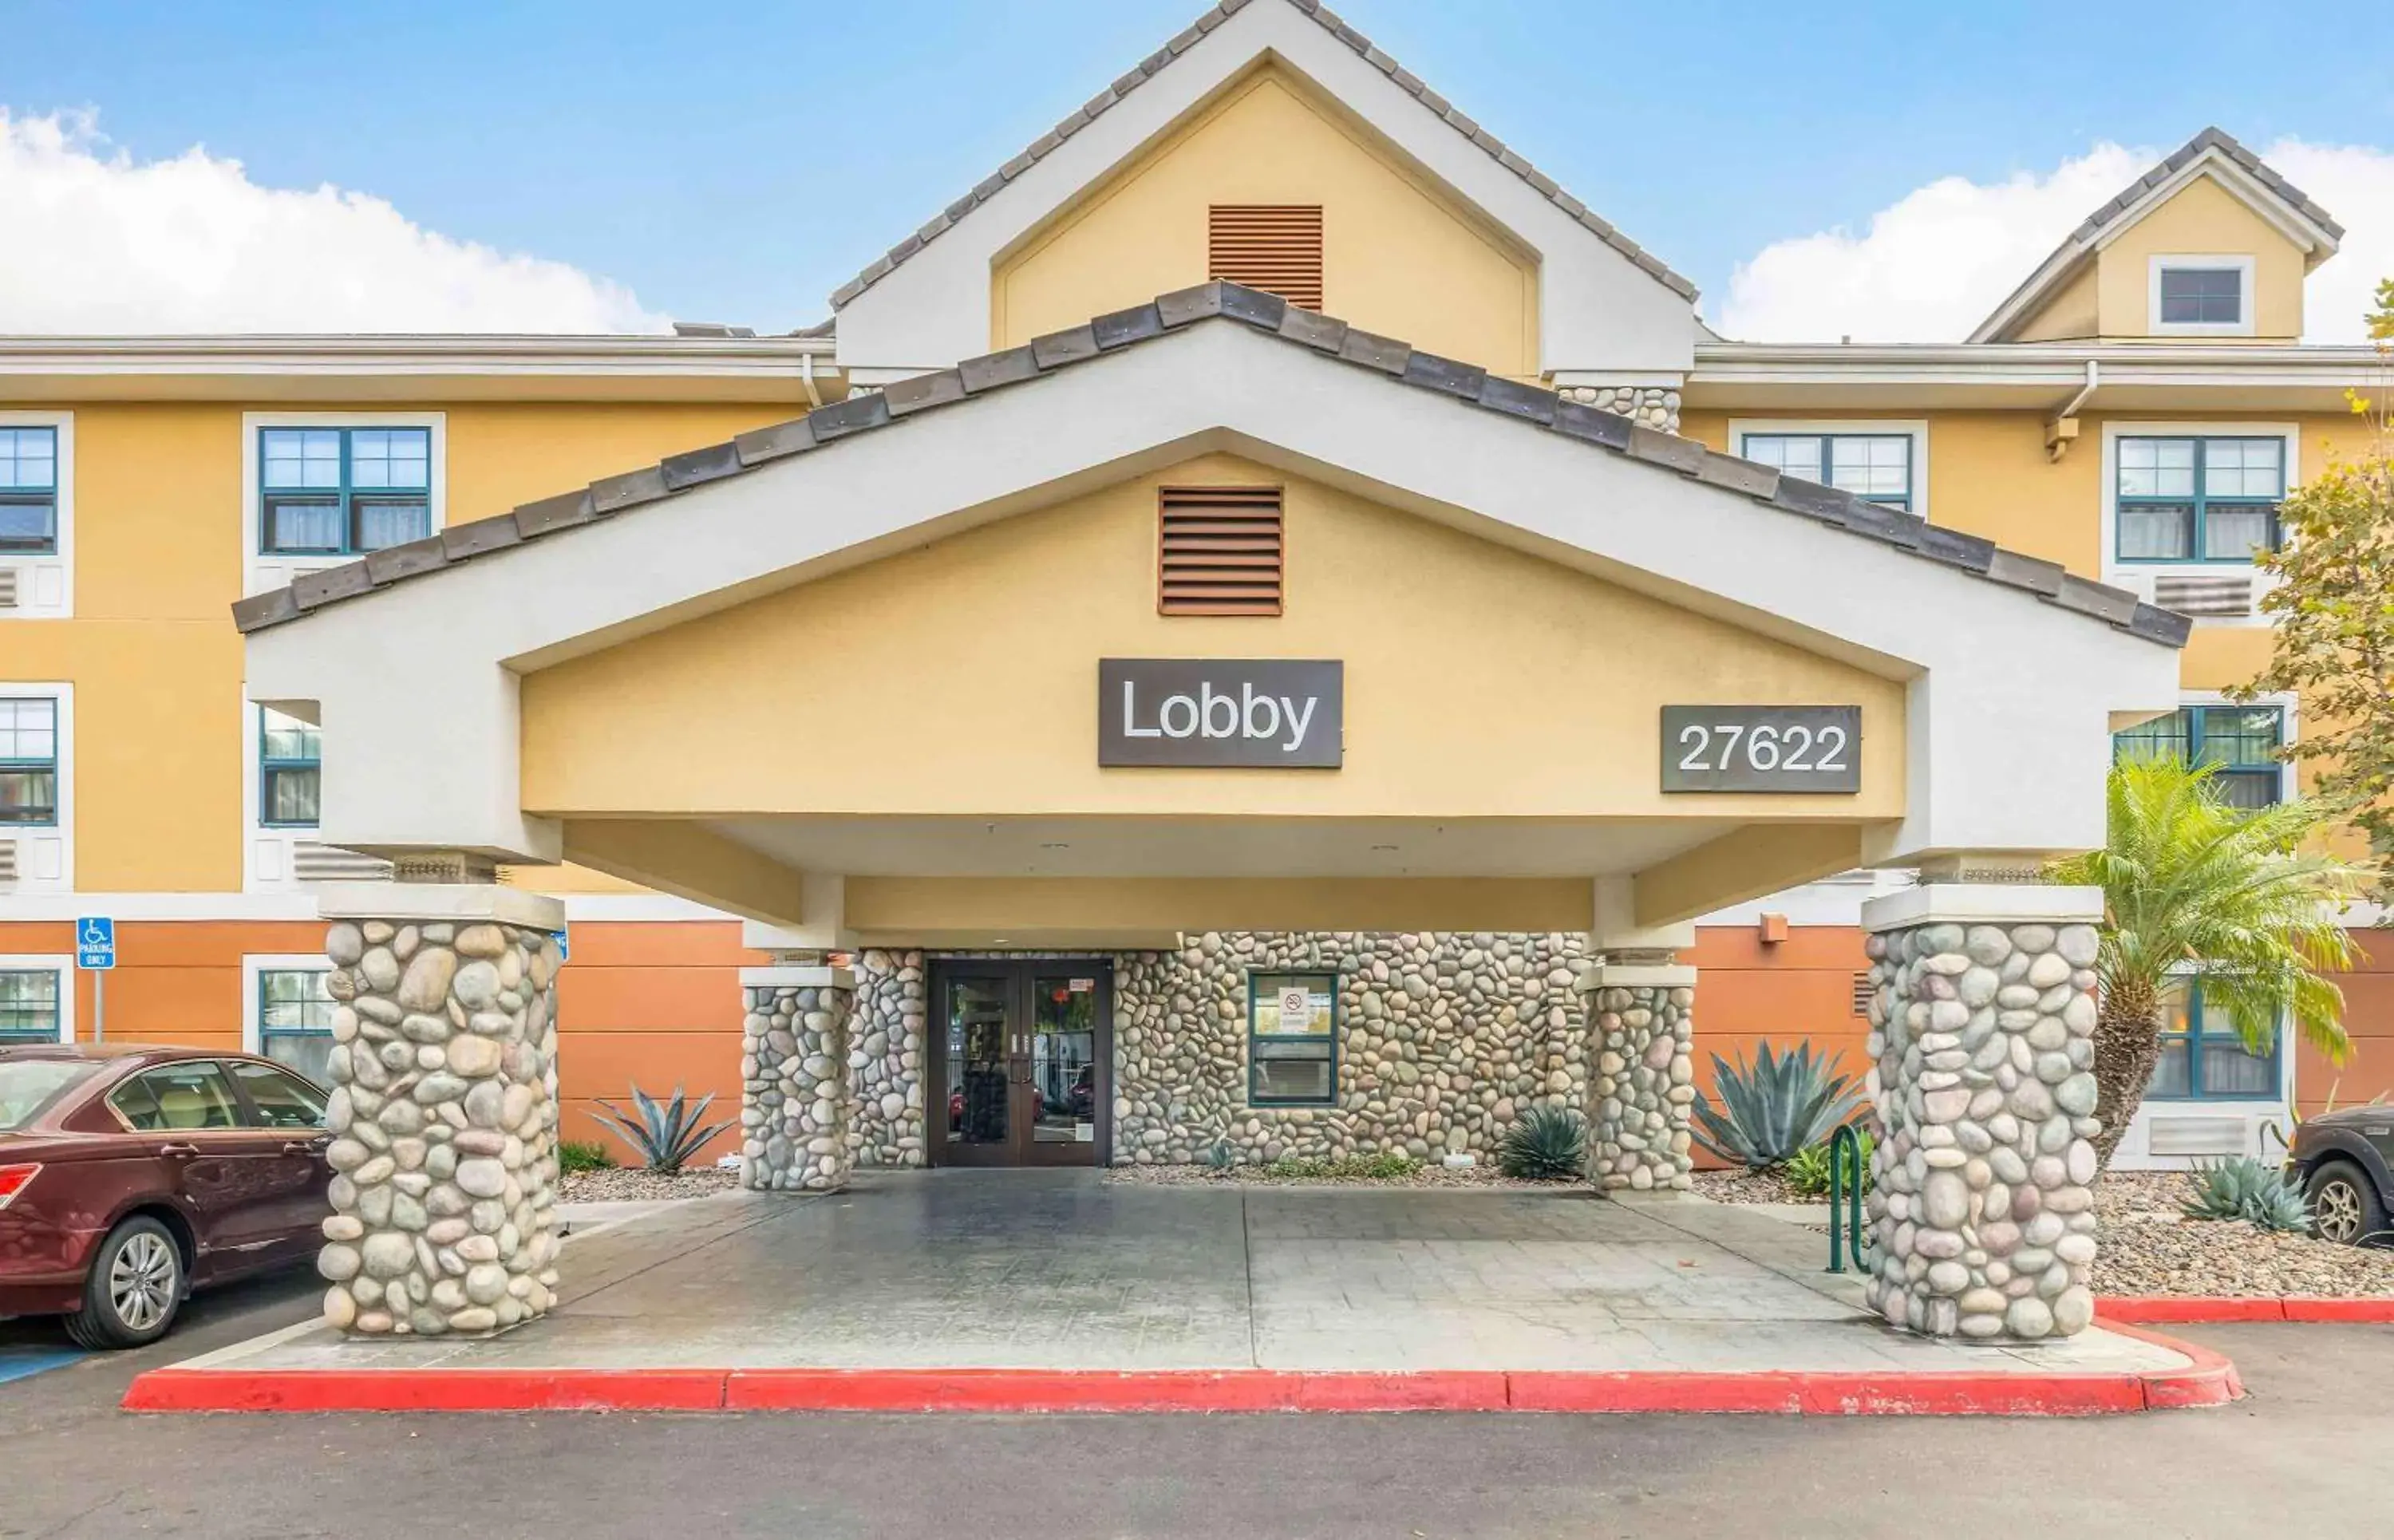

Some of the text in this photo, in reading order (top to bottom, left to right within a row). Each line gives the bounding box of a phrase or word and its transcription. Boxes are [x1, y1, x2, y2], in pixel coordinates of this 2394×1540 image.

[1124, 681, 1317, 752] Lobby
[1678, 725, 1847, 772] 27622
[80, 943, 113, 954] PARKING
[86, 954, 105, 965] ONLY
